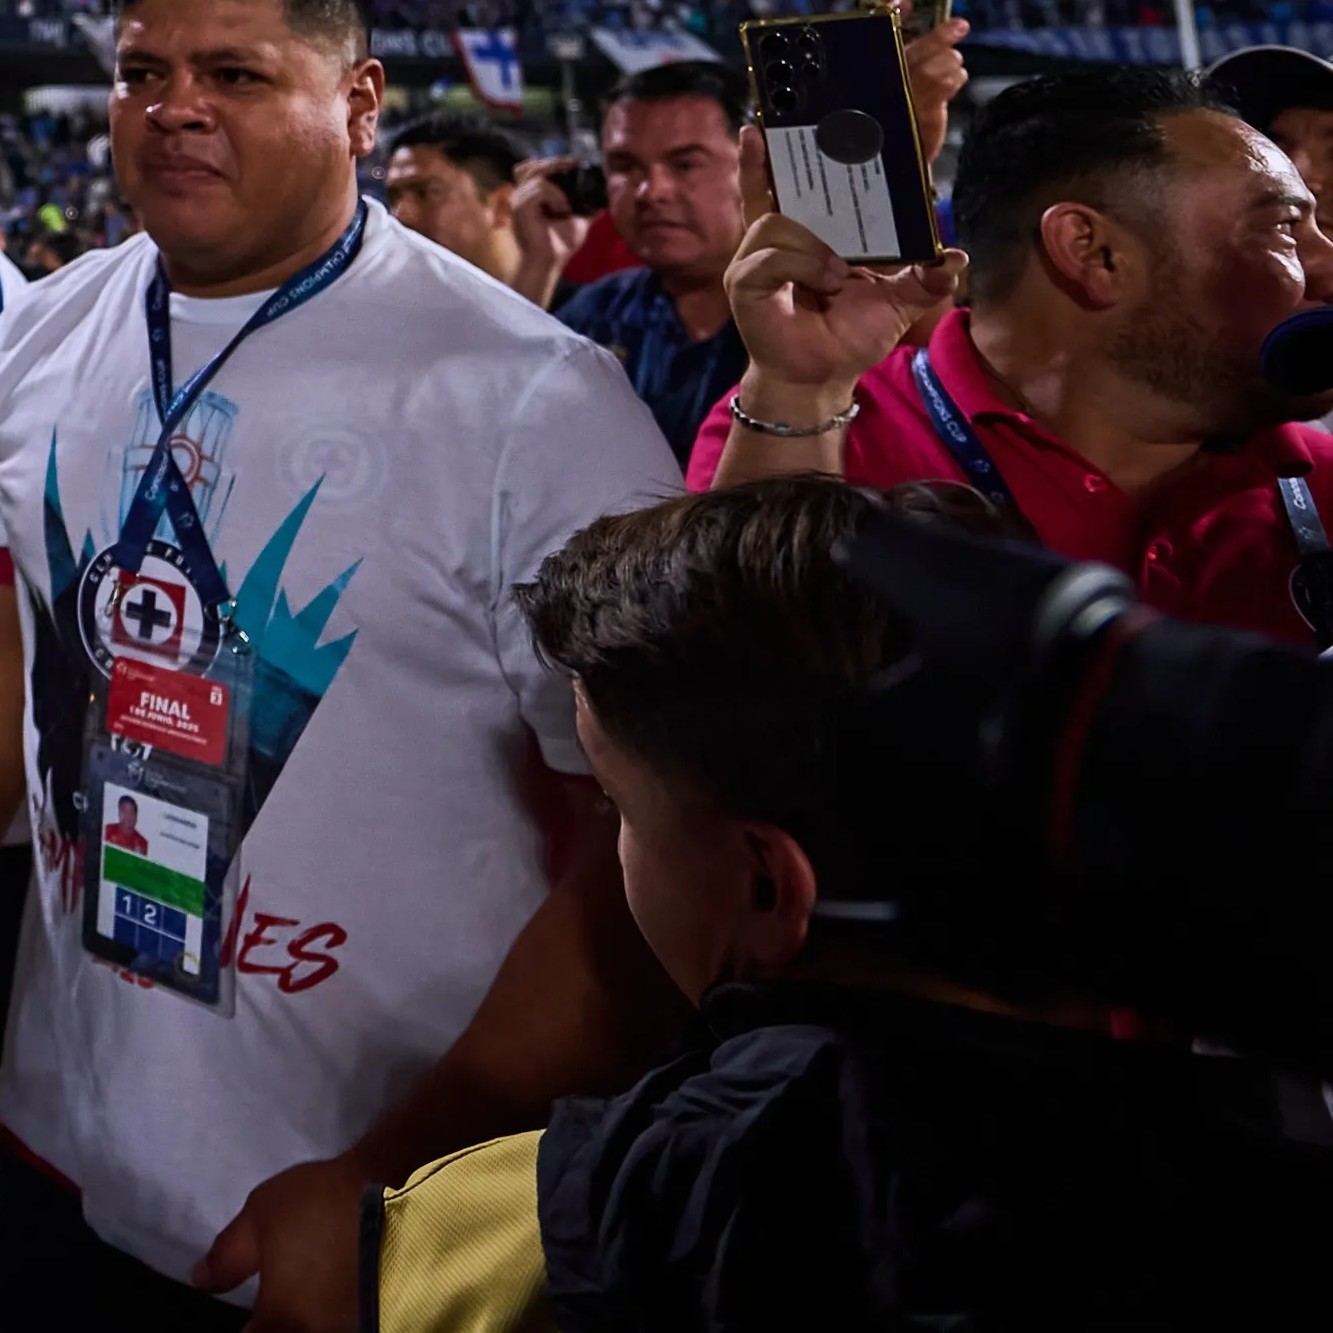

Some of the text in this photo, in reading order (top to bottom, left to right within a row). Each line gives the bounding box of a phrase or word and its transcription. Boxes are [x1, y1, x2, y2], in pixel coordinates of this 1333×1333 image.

[140, 691, 190, 721] FINAL
[122, 895, 157, 925] 1 2
